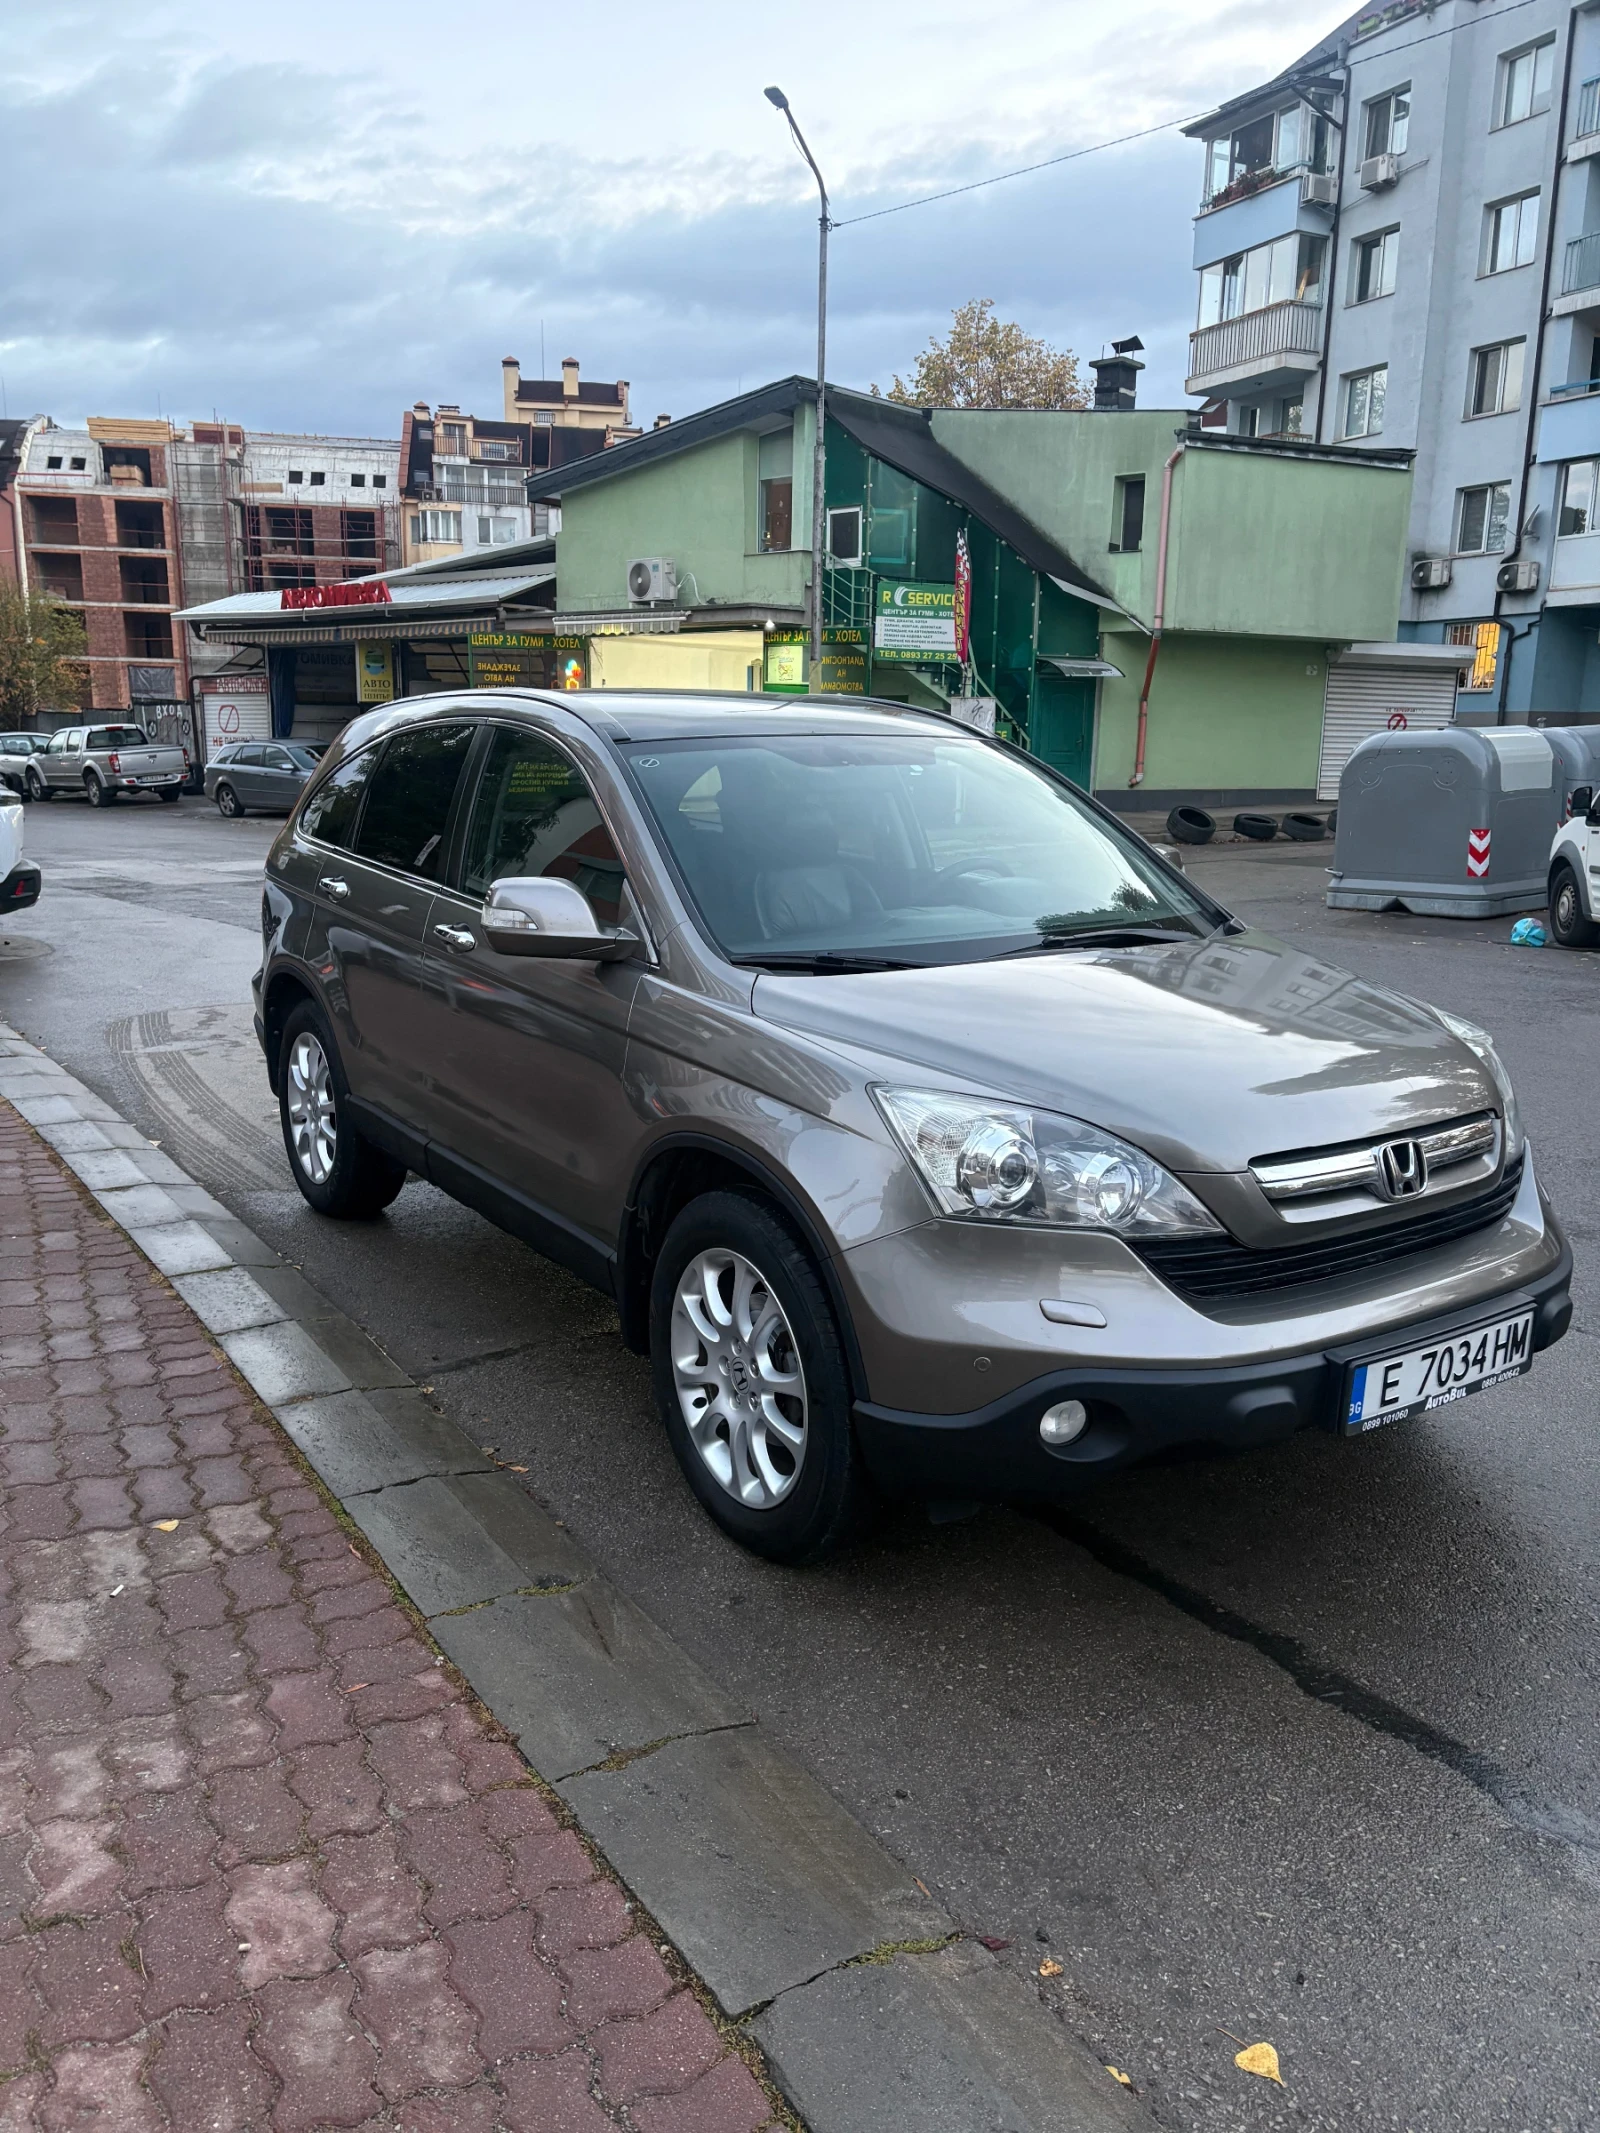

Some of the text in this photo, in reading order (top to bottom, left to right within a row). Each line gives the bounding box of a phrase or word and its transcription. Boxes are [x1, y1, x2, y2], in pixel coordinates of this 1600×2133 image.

[471, 633, 503, 646] ЦЕНТЪР
[506, 635, 518, 646] ЗА
[520, 635, 544, 647] ГУМИ
[553, 637, 580, 648] ХОТЕЛ
[764, 630, 792, 643] ЦЕНТЪР
[793, 630, 804, 642] ЗА
[835, 630, 862, 642] ХОТЕЛ
[901, 651, 920, 659] 0893
[363, 679, 391, 688] АВТО
[1380, 1318, 1530, 1408] E 7034 HM
[1362, 1408, 1409, 1432] 0899 101060
